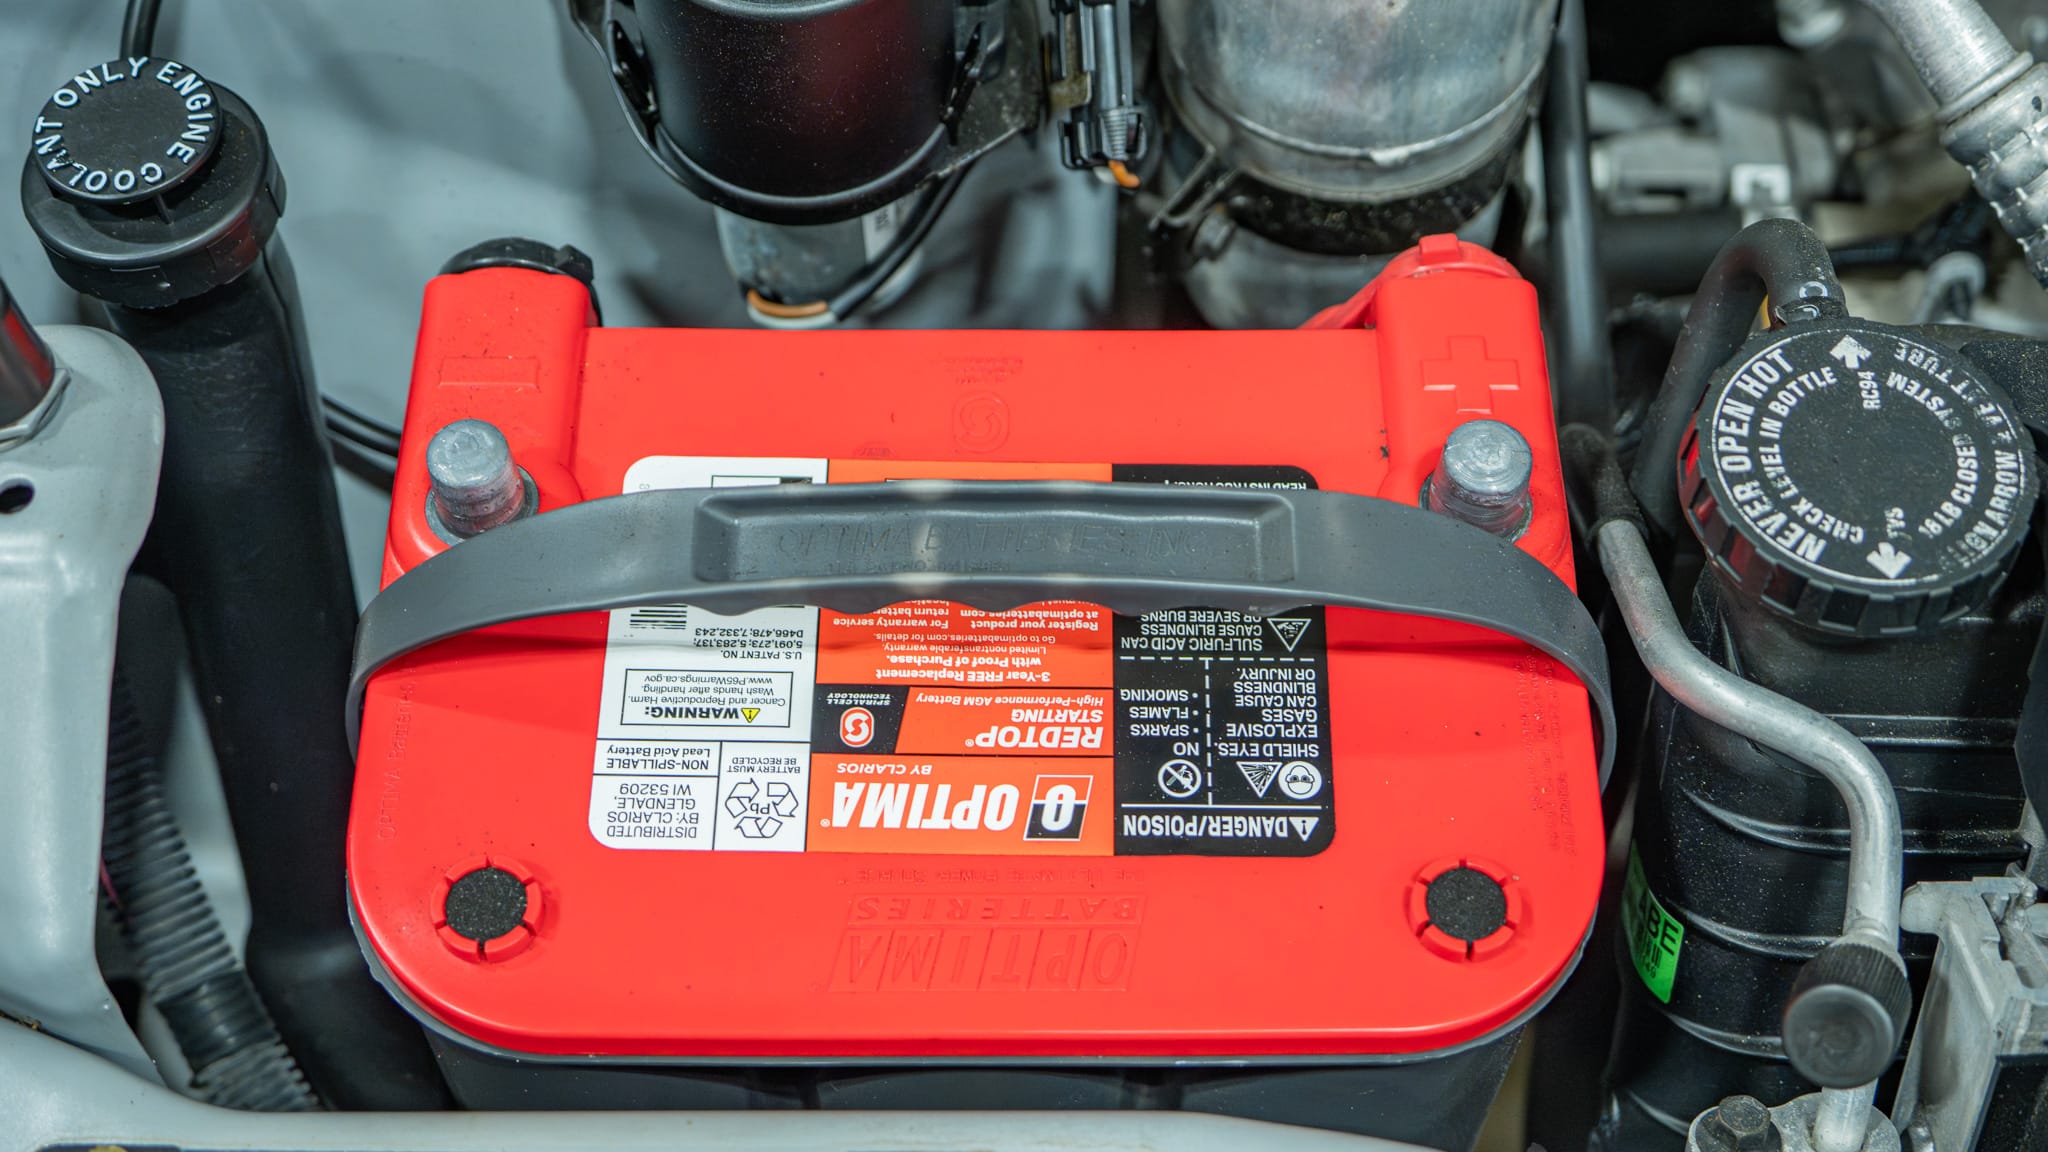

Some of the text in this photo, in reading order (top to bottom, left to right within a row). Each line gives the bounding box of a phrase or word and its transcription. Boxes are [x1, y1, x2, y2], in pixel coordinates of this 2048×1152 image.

[34, 56, 214, 192] ENGINE COOLANT ONLY
[1894, 342, 1953, 384] TUBE
[1768, 366, 1838, 418] BOTTLE
[1857, 370, 1881, 410] RC94
[1758, 417, 1783, 439] IN
[1718, 348, 1827, 562] NEVER OPEN HOT
[1933, 501, 1963, 528] LB
[1951, 434, 1979, 505] CLOSED
[1984, 449, 2019, 526] ARROW
[1790, 497, 1865, 544] CHECK
[871, 607, 949, 617] return batter
[1086, 610, 1098, 619] at
[1189, 610, 1241, 622] SEVERE
[833, 618, 948, 629] For warranty service
[971, 620, 1098, 631] Register your product
[1141, 623, 1262, 635] CAUSE BLINDNESS
[695, 627, 804, 638] D466,478; 7,332,243
[873, 633, 1056, 644] Go to optimabatteries.com for details.
[693, 638, 803, 648] 5,091,273; 5,283,137;
[882, 643, 1046, 655] Limited nontransferable warranty.
[1121, 637, 1263, 651] SULFURIC ACID CAN
[720, 650, 802, 660] U.S. PATENT NO.
[886, 655, 1041, 667] with Proof of Purchase.
[645, 674, 772, 685] www.P65Warnings.ca.gov
[875, 668, 1051, 682] 3-Year FREE Replacement
[1236, 667, 1316, 680] OR INJURY.
[641, 684, 774, 696] Wash hands after handling.
[1233, 681, 1316, 693] BLINDNESS
[628, 695, 786, 706] Cancer and Reproductive Harm.
[916, 693, 1104, 707] High-Performance AGM Battery
[1119, 688, 1189, 701] SMOKING
[1235, 694, 1317, 707] CAN CAUSE
[826, 698, 891, 706] SPIRALCELL
[645, 706, 739, 719] WARNING:
[1011, 709, 1103, 722] STARTING
[1129, 706, 1189, 718] FLAMES
[1261, 708, 1318, 722] GASES
[1130, 724, 1190, 736] SPARKS
[1226, 723, 1318, 738] EXPLOSIVE
[607, 745, 711, 757] Lead Acid Battery
[1172, 742, 1199, 756] NO
[1213, 741, 1319, 757] SHIELD EYES.
[606, 758, 709, 770] NON-SPILLABLE
[784, 757, 797, 765] BE
[727, 765, 801, 773] BATTERY MUST
[837, 763, 933, 775] BY CLARIOS
[620, 783, 691, 795] WI 53209
[614, 796, 696, 809] GLENDALE,
[750, 802, 770, 814] Pb
[607, 811, 699, 823] BY: CLARIOS
[606, 825, 697, 838] DISTRIBUTED
[1123, 814, 1288, 838] DANGER/POISON
[855, 897, 1138, 921] BATTERIES
[846, 932, 1130, 986] OPTIMA
